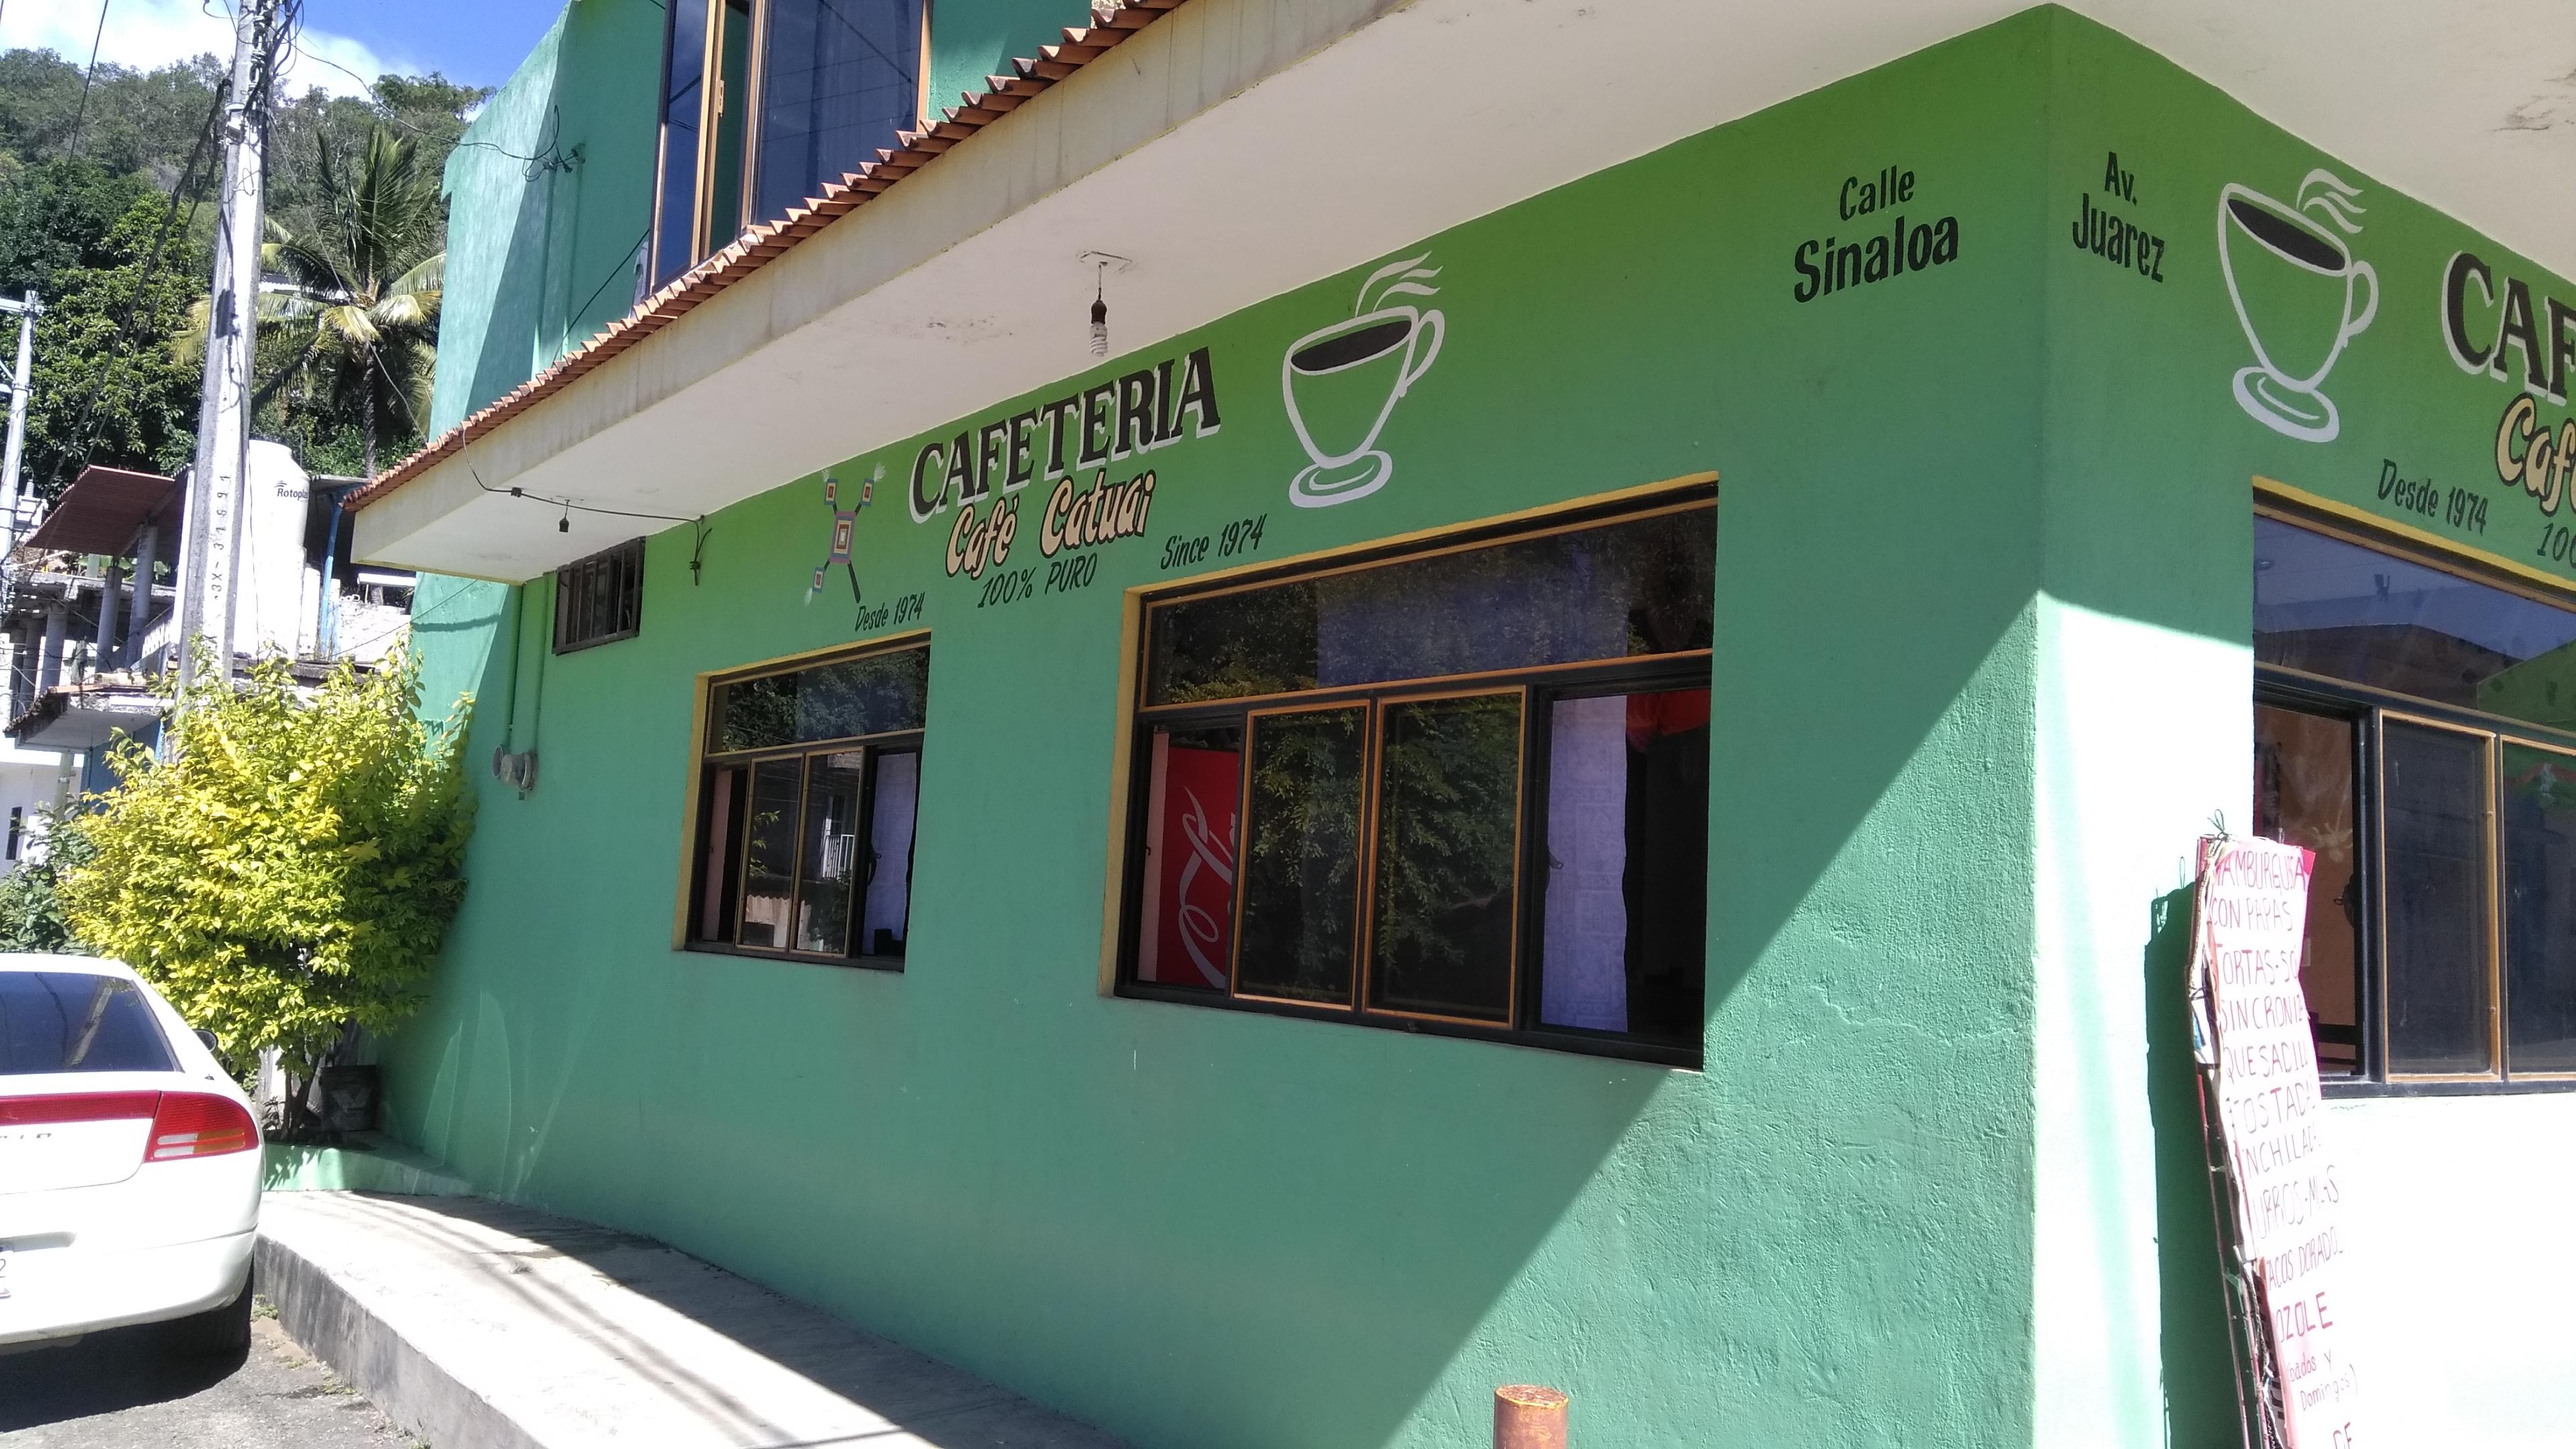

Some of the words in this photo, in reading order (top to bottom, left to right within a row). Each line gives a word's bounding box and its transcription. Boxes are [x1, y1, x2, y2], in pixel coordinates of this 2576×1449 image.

[1839, 164, 1915, 221] Calle
[2104, 151, 2137, 206] Av.
[1793, 215, 1959, 303] Sinaloa
[2072, 193, 2165, 284] Juarez
[908, 346, 1221, 524] CAFETERIA
[2377, 458, 2438, 518] Desde
[2446, 486, 2488, 536] 1974
[945, 492, 1020, 581] Café
[1160, 535, 1210, 570] Since
[1218, 513, 1268, 557] 1974
[977, 566, 1037, 608] 100%
[1044, 552, 1097, 595] PURO
[855, 601, 889, 632] Desde
[893, 591, 926, 625] 1974
[2246, 897, 2293, 932] PAPAS
[2275, 1291, 2334, 1343] OZOLE
